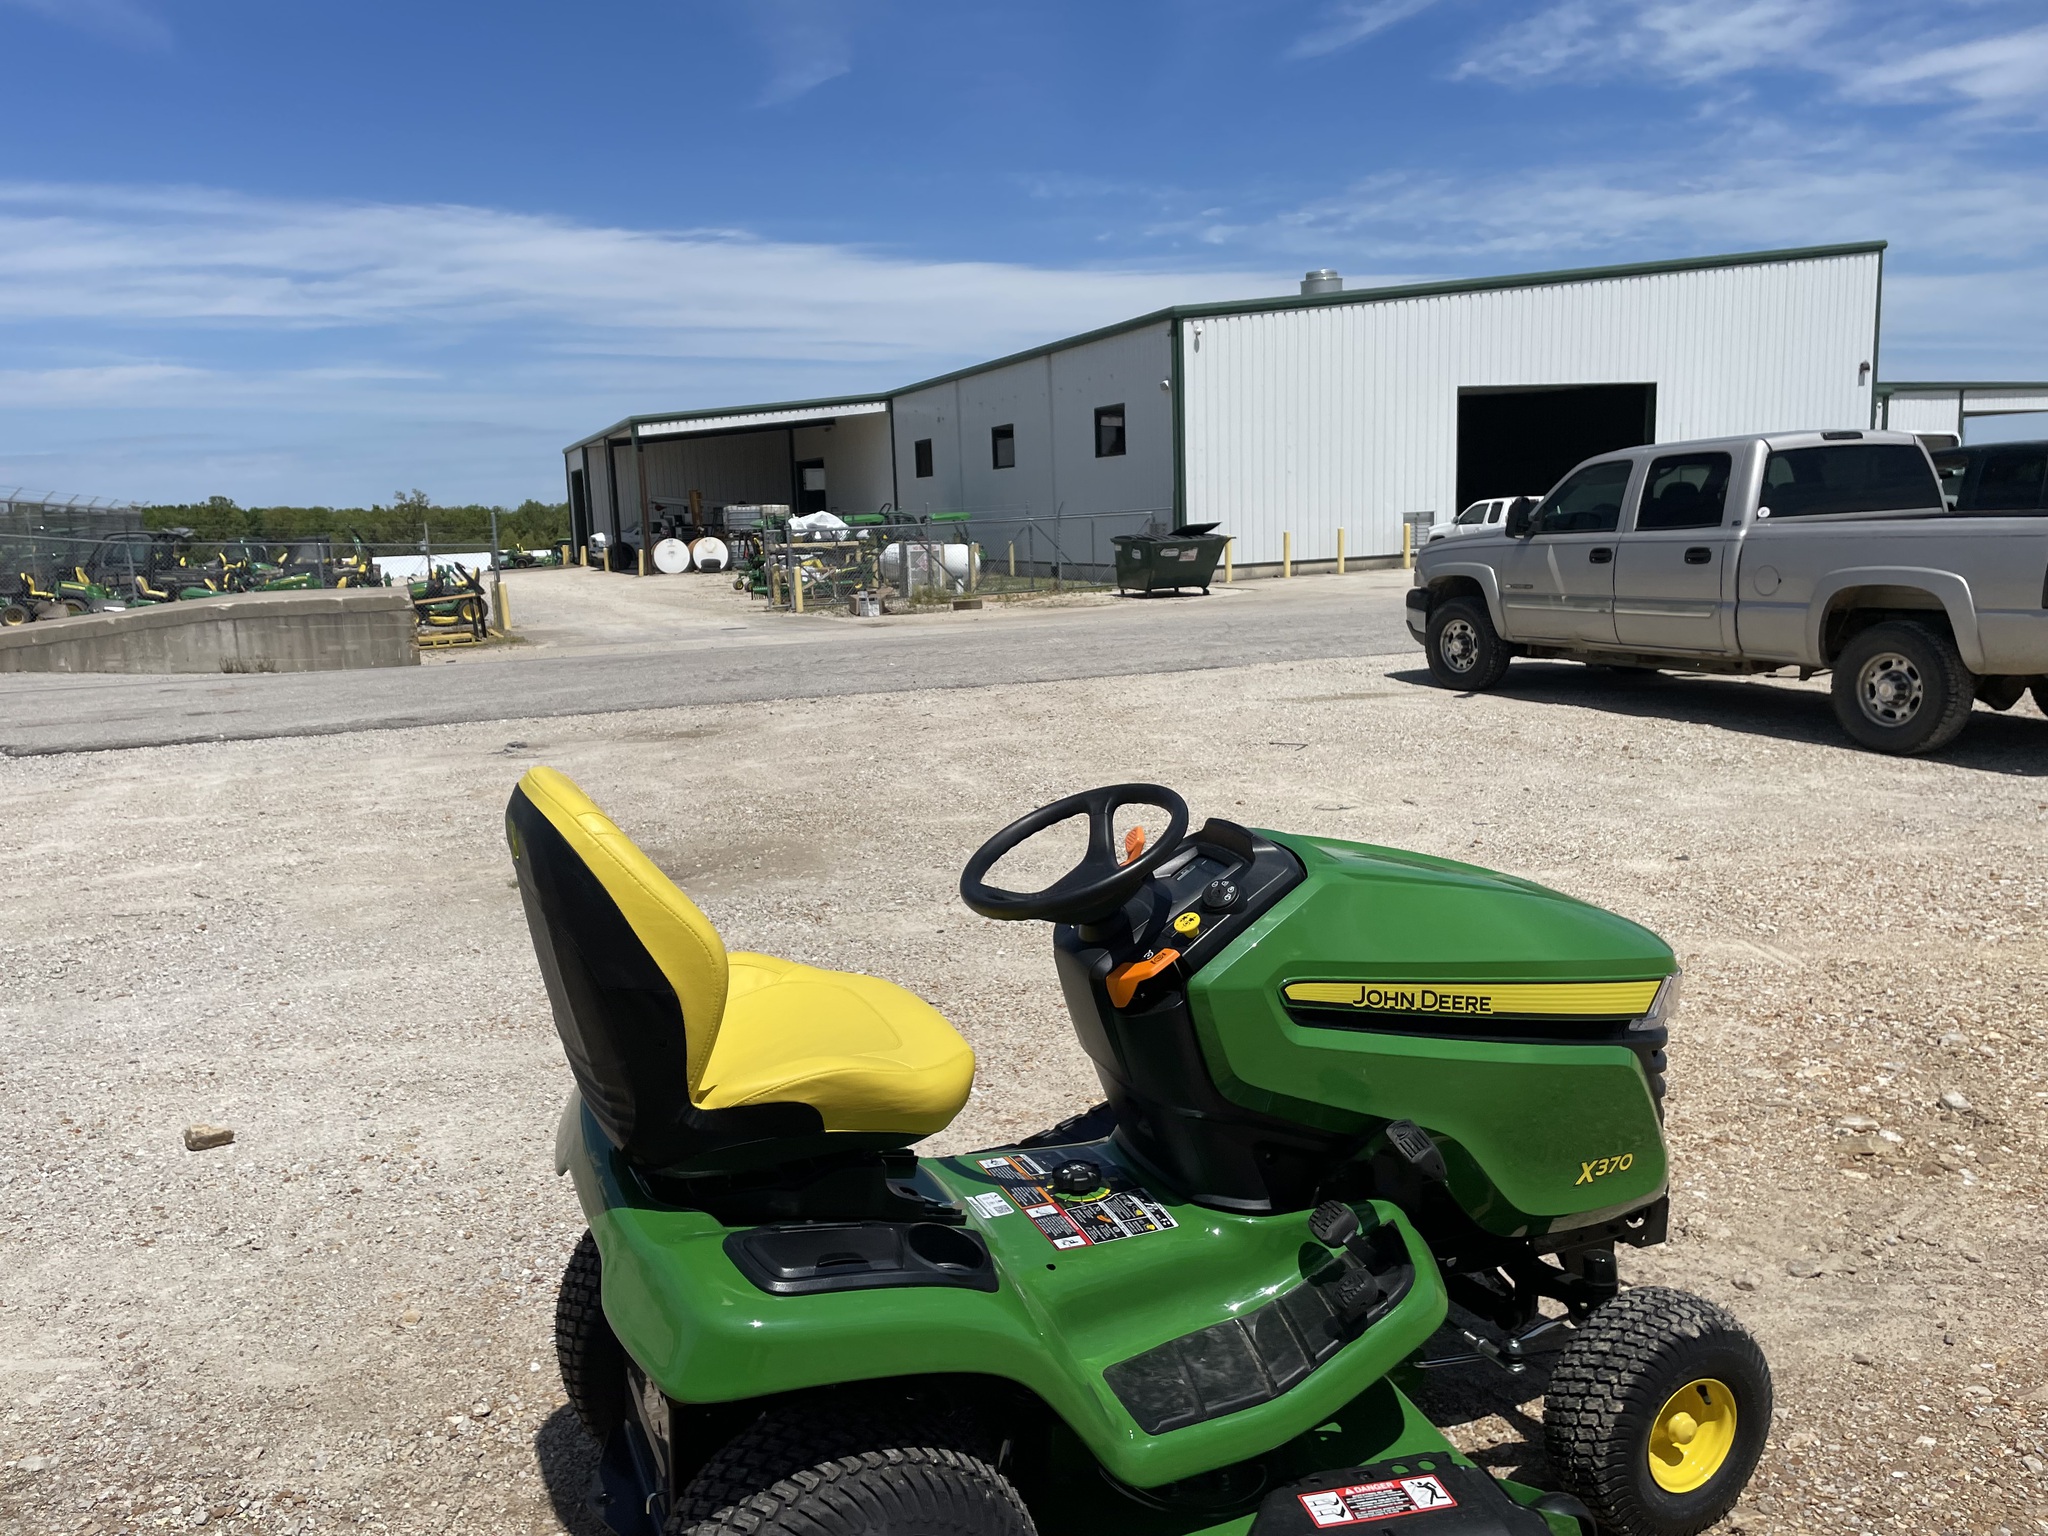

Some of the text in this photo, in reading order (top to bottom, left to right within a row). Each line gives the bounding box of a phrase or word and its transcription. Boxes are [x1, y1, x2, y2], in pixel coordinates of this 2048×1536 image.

[1352, 985, 1492, 1013] JOHN DEERE
[1574, 1152, 1633, 1186] X370
[1353, 1481, 1395, 1494] DANGER
